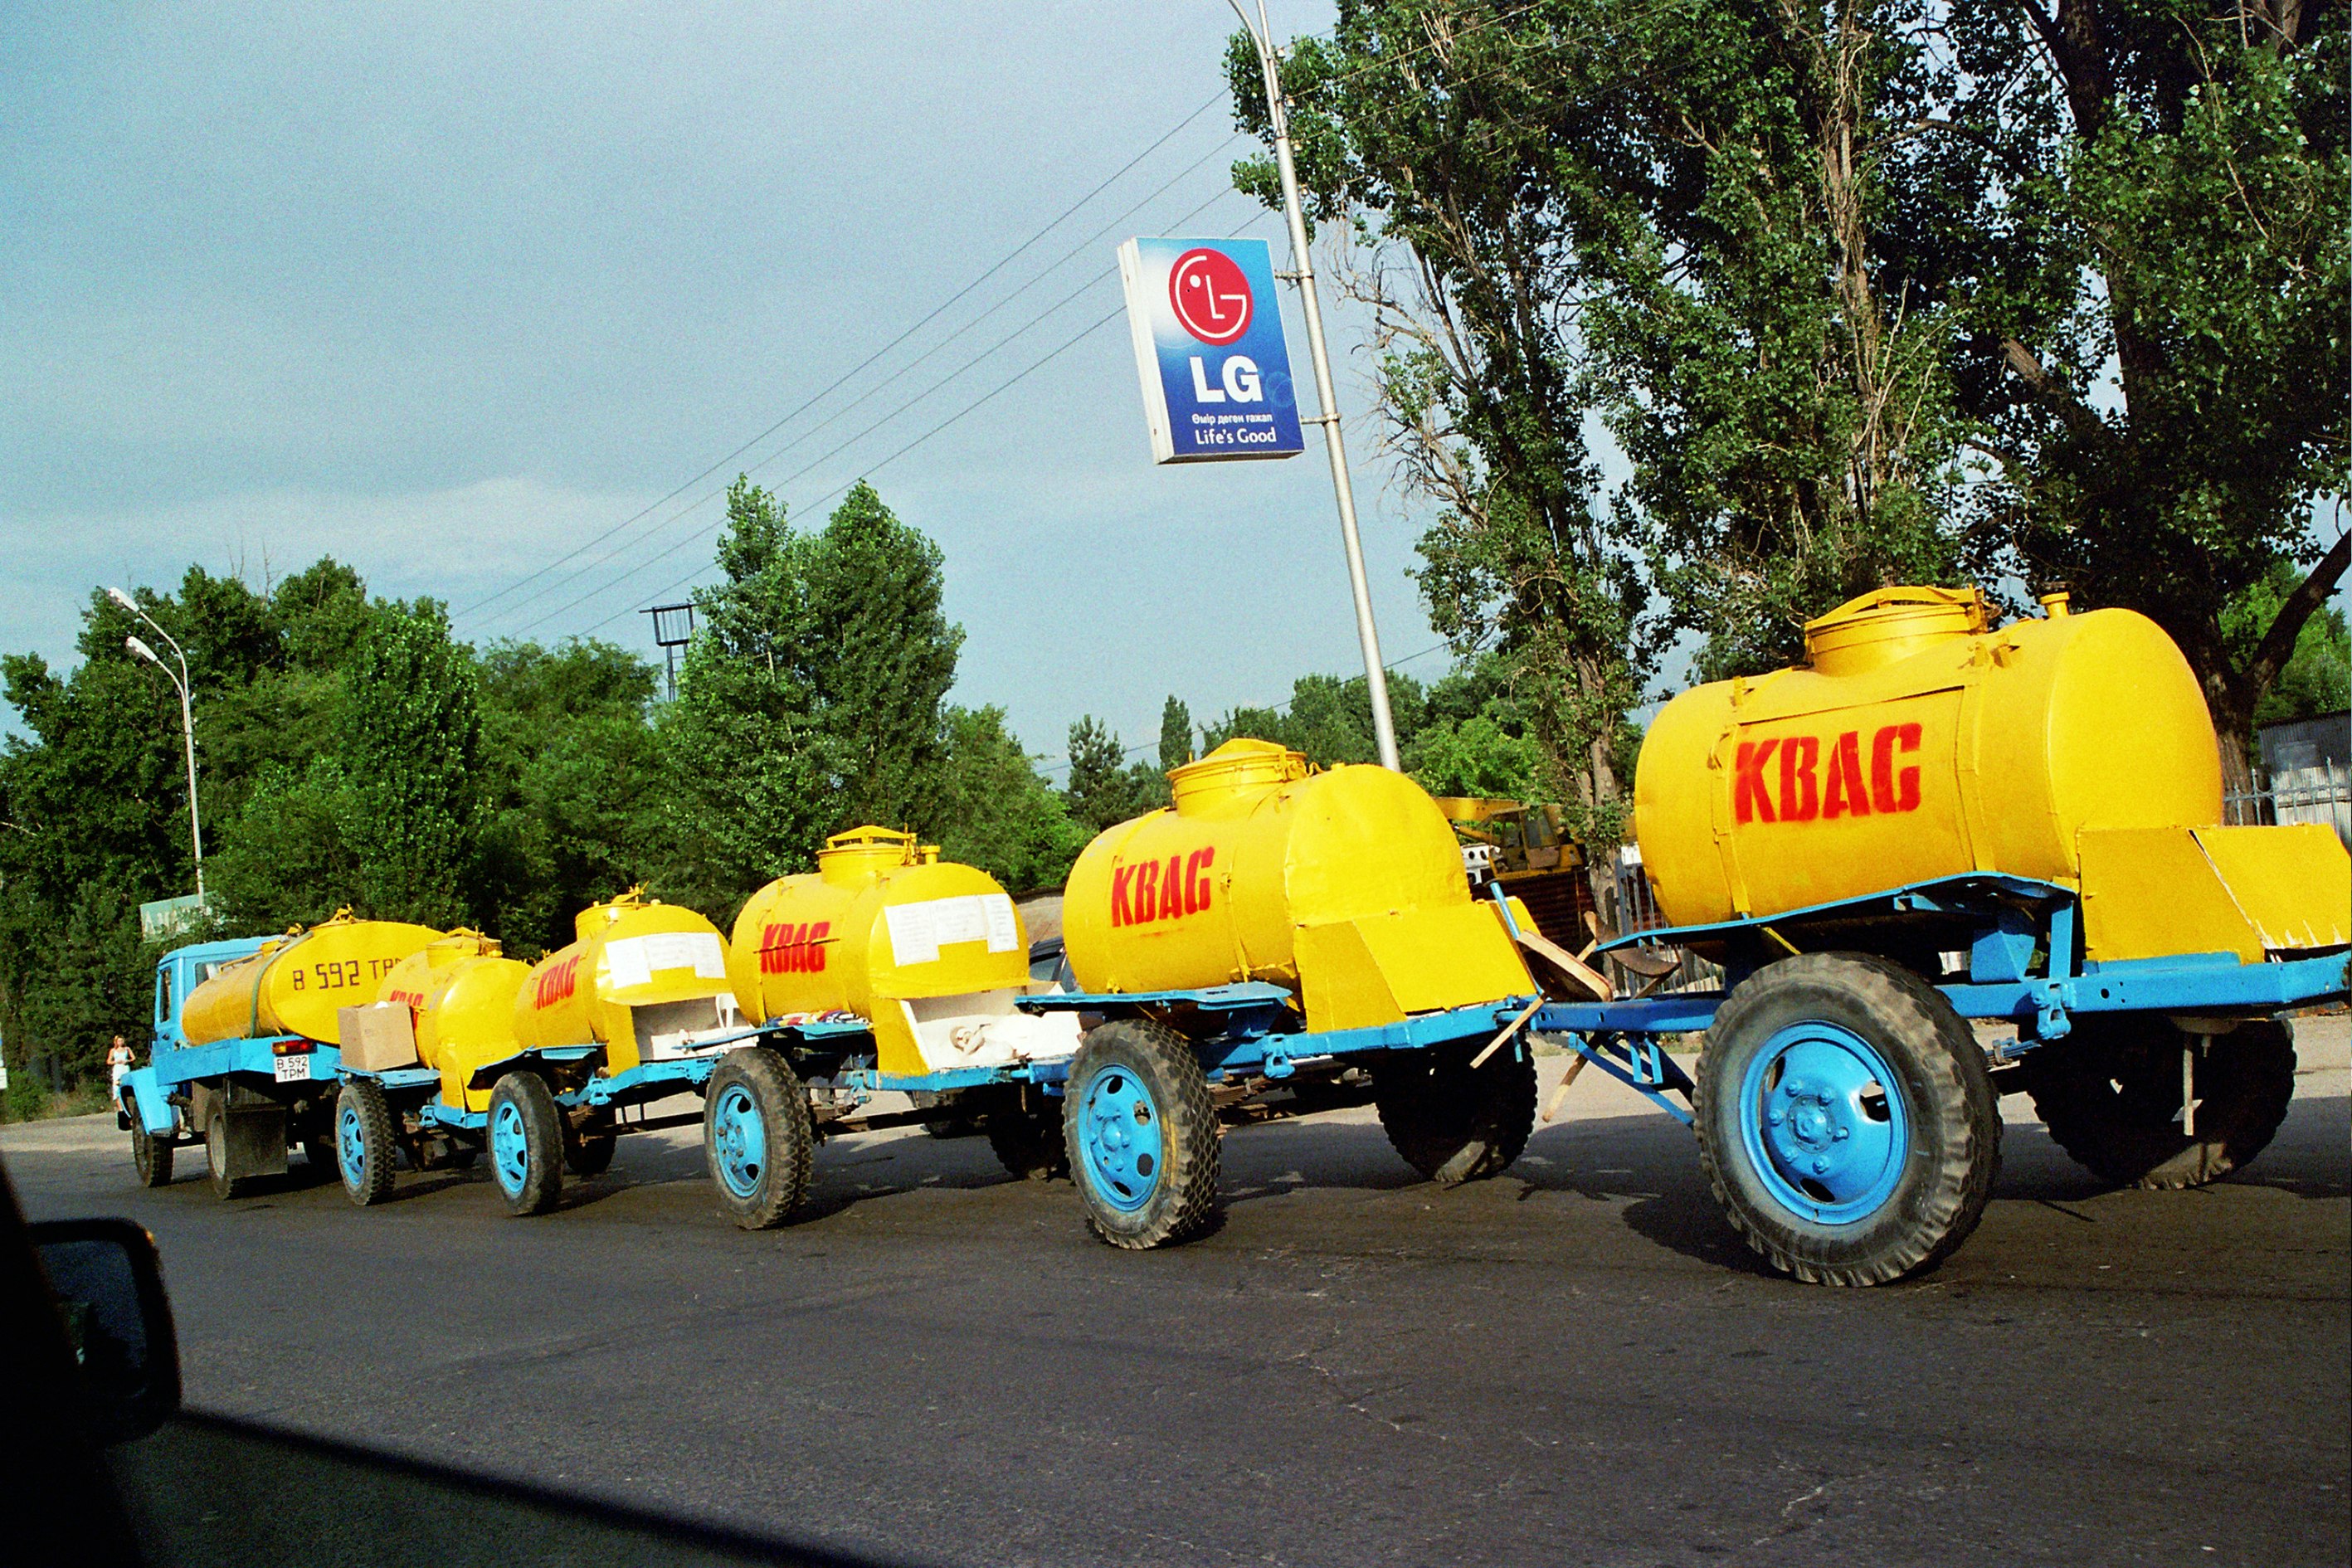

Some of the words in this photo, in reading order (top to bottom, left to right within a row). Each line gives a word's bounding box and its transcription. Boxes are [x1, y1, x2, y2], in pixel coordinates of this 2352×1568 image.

[1189, 355, 1263, 402] LG
[1191, 413, 1216, 426] Өмір
[1195, 428, 1234, 445] Life's
[1237, 426, 1277, 444] Good
[1734, 722, 1923, 825] КВАС
[1112, 846, 1215, 928] КВАС
[760, 921, 830, 974] КВАС
[315, 960, 360, 989] 592
[368, 958, 402, 980] TP
[276, 1058, 284, 1069] B
[288, 1055, 308, 1068] 592
